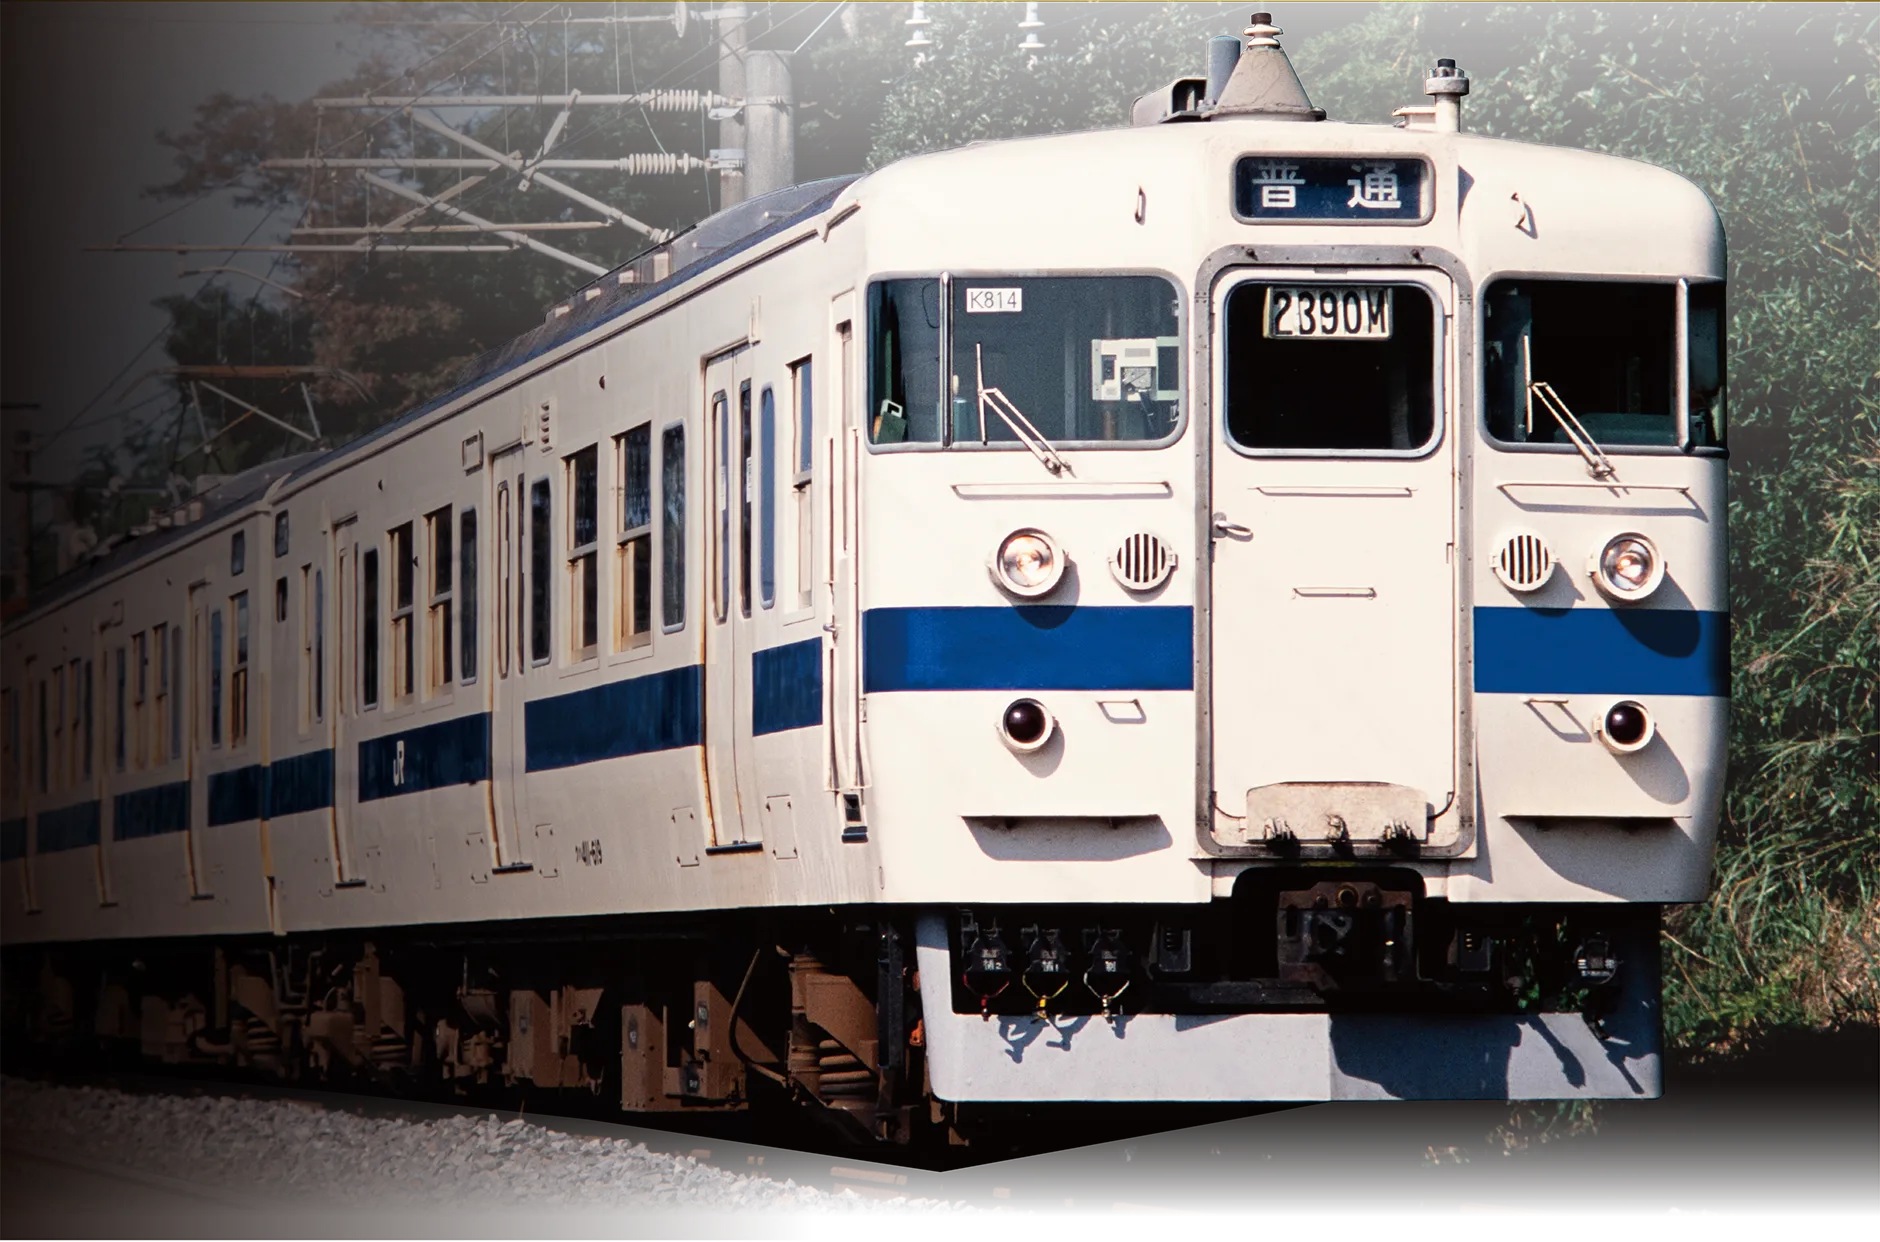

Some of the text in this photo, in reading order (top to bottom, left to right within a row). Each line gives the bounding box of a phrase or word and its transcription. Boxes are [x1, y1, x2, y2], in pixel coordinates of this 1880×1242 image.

[1252, 160, 1402, 209] 普通
[970, 291, 1017, 309] K814
[1273, 290, 1387, 336] 2390M
[393, 740, 405, 786] JR
